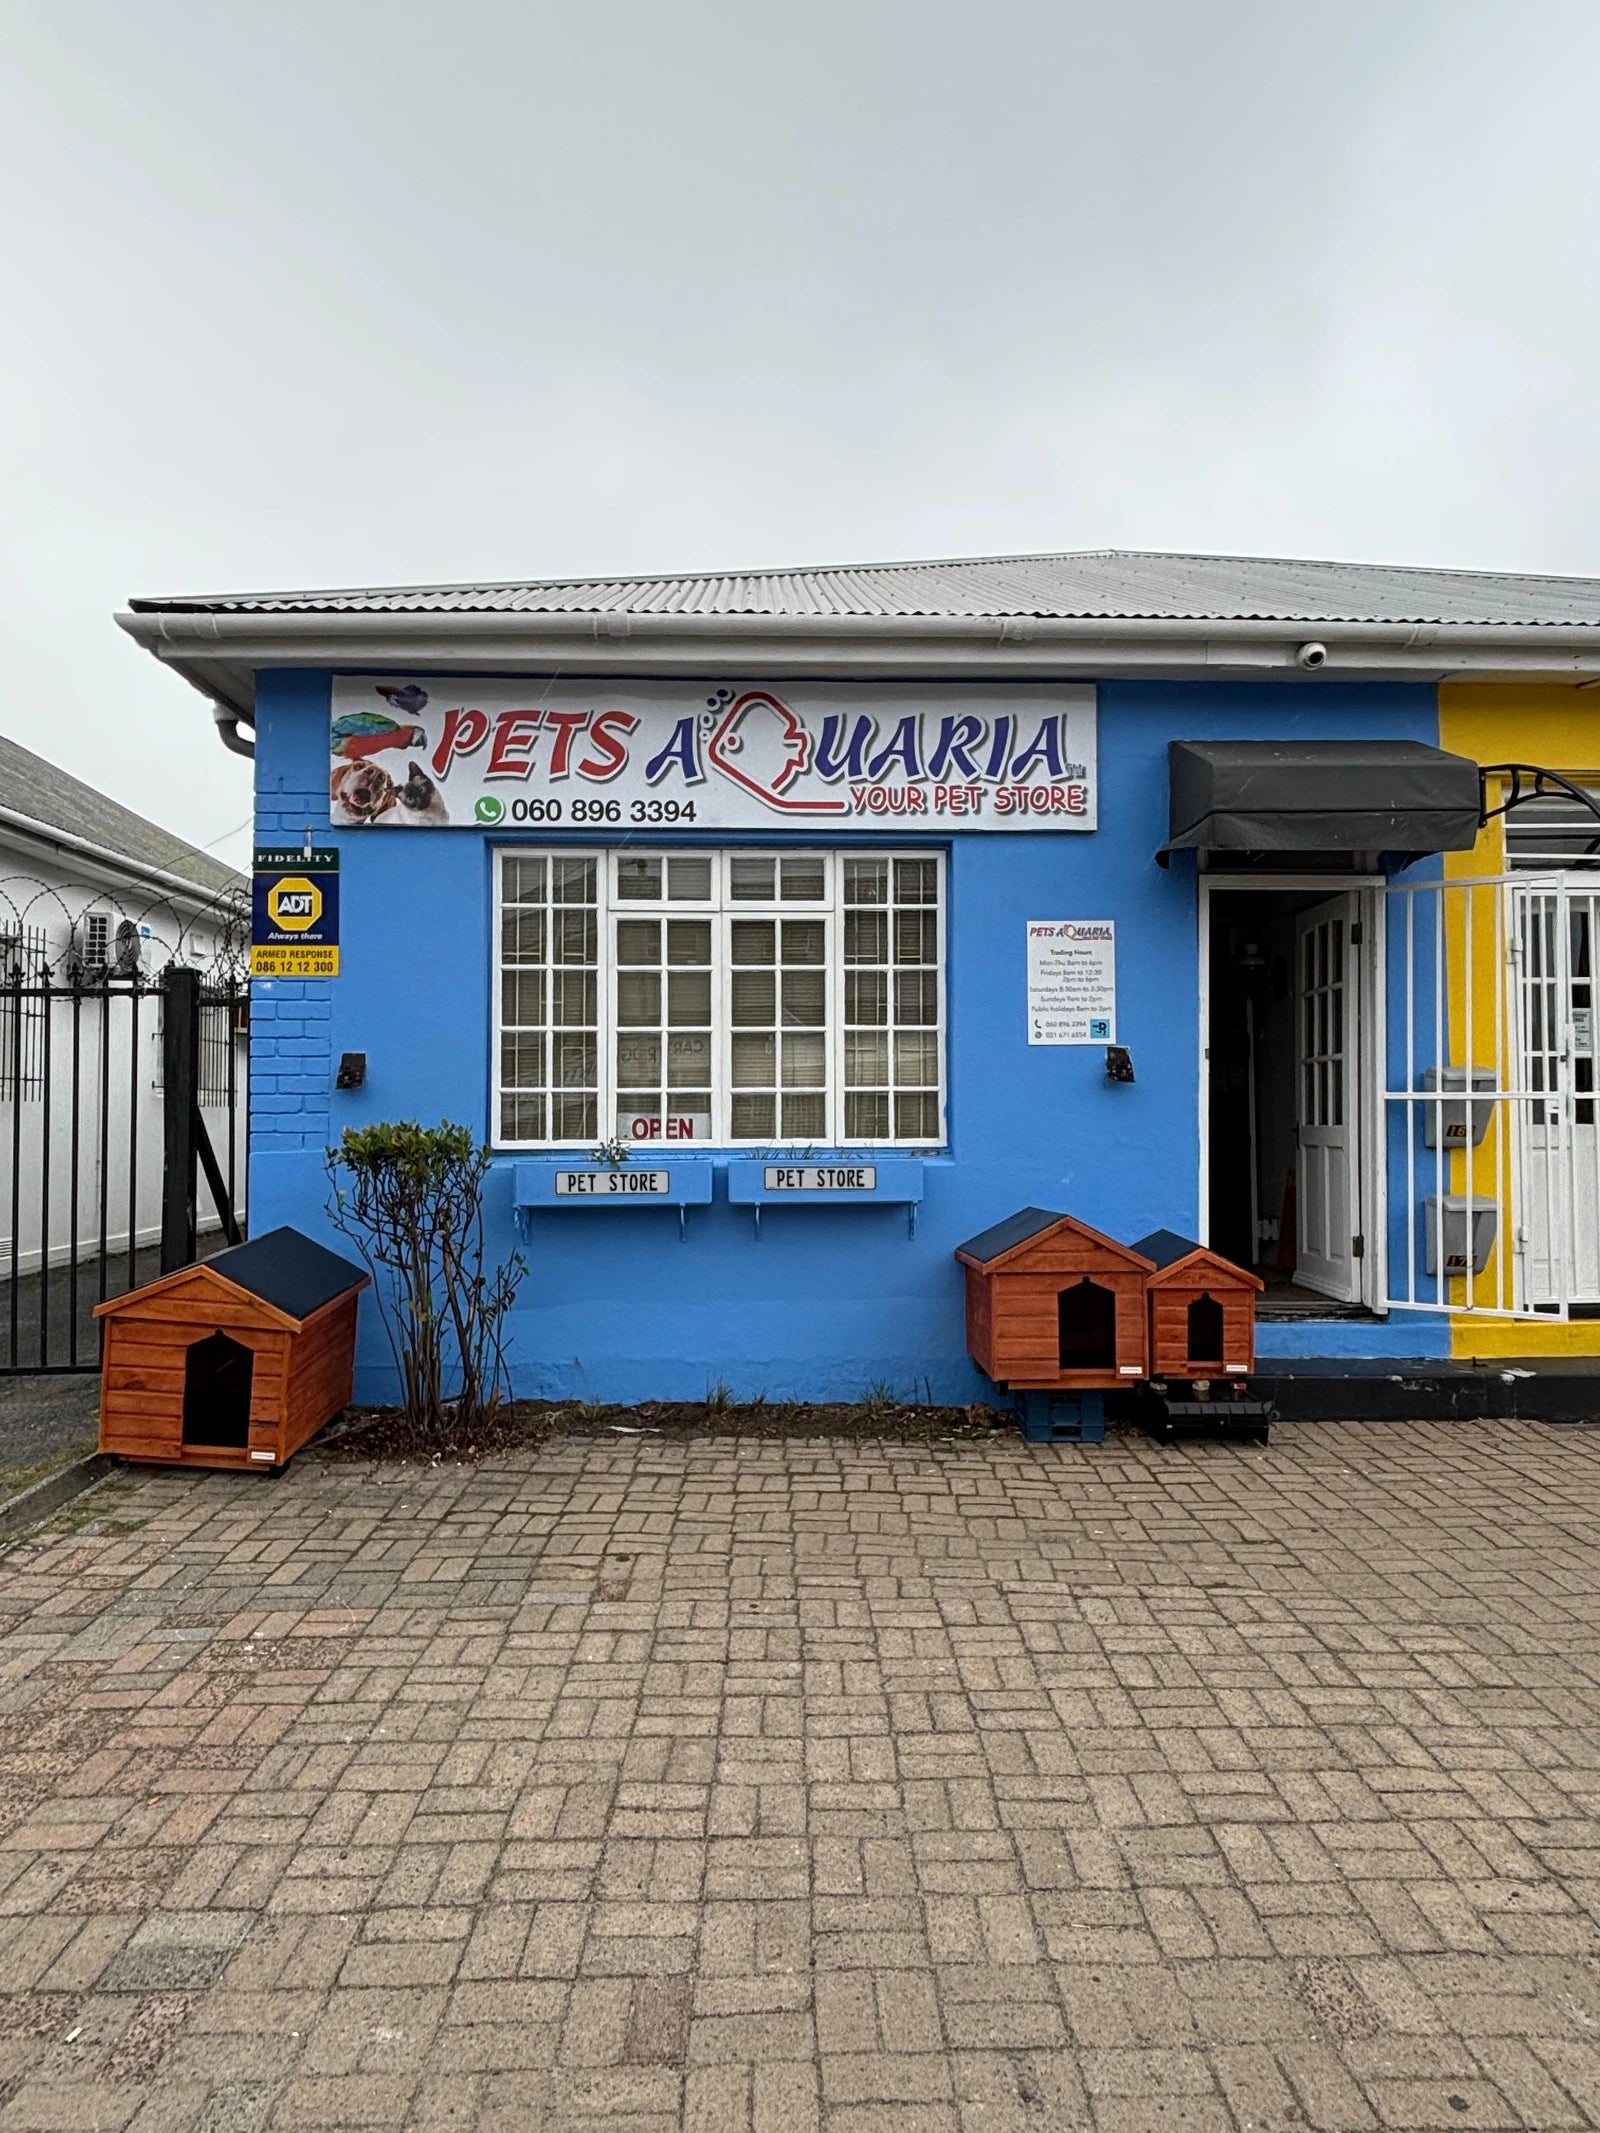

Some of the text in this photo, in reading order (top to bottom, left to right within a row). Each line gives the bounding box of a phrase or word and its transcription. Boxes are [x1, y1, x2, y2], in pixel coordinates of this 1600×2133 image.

[432, 708, 639, 782] PETS
[850, 784, 1085, 813] YOUR PET STORE
[511, 798, 697, 823] 060 896 3394
[257, 855, 334, 863] FIDELITY
[278, 895, 313, 914] ADT
[267, 932, 323, 941] Always there
[1029, 927, 1056, 938] PETS
[256, 950, 334, 959] ARMED RESPONSE
[1050, 949, 1073, 957] Trading
[255, 961, 334, 972] 086 12 12 300
[631, 1117, 694, 1140] OPEN
[568, 1173, 659, 1192] PET STORE
[776, 1169, 865, 1188] PET STORE
